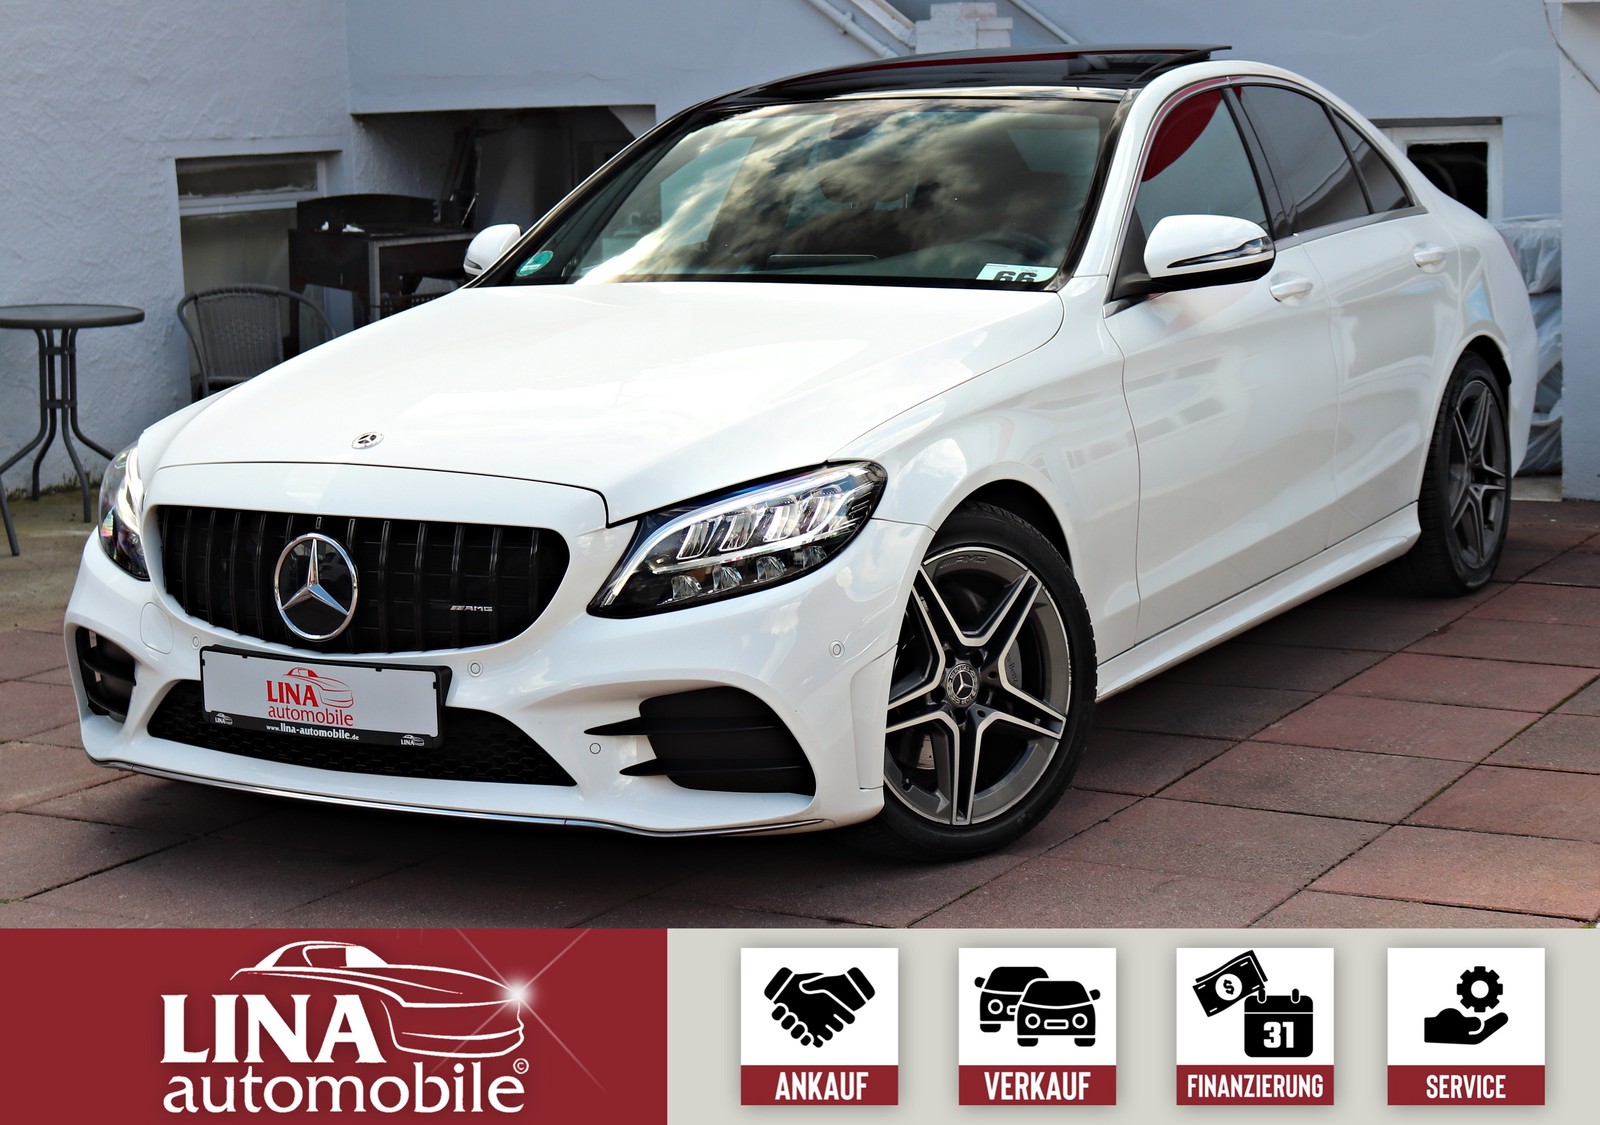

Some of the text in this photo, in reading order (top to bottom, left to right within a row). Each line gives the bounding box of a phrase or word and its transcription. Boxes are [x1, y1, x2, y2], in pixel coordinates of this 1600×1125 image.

[266, 680, 319, 707] LINA
[268, 705, 354, 727] automobile
[266, 722, 360, 741] www.lina-automobile.de
